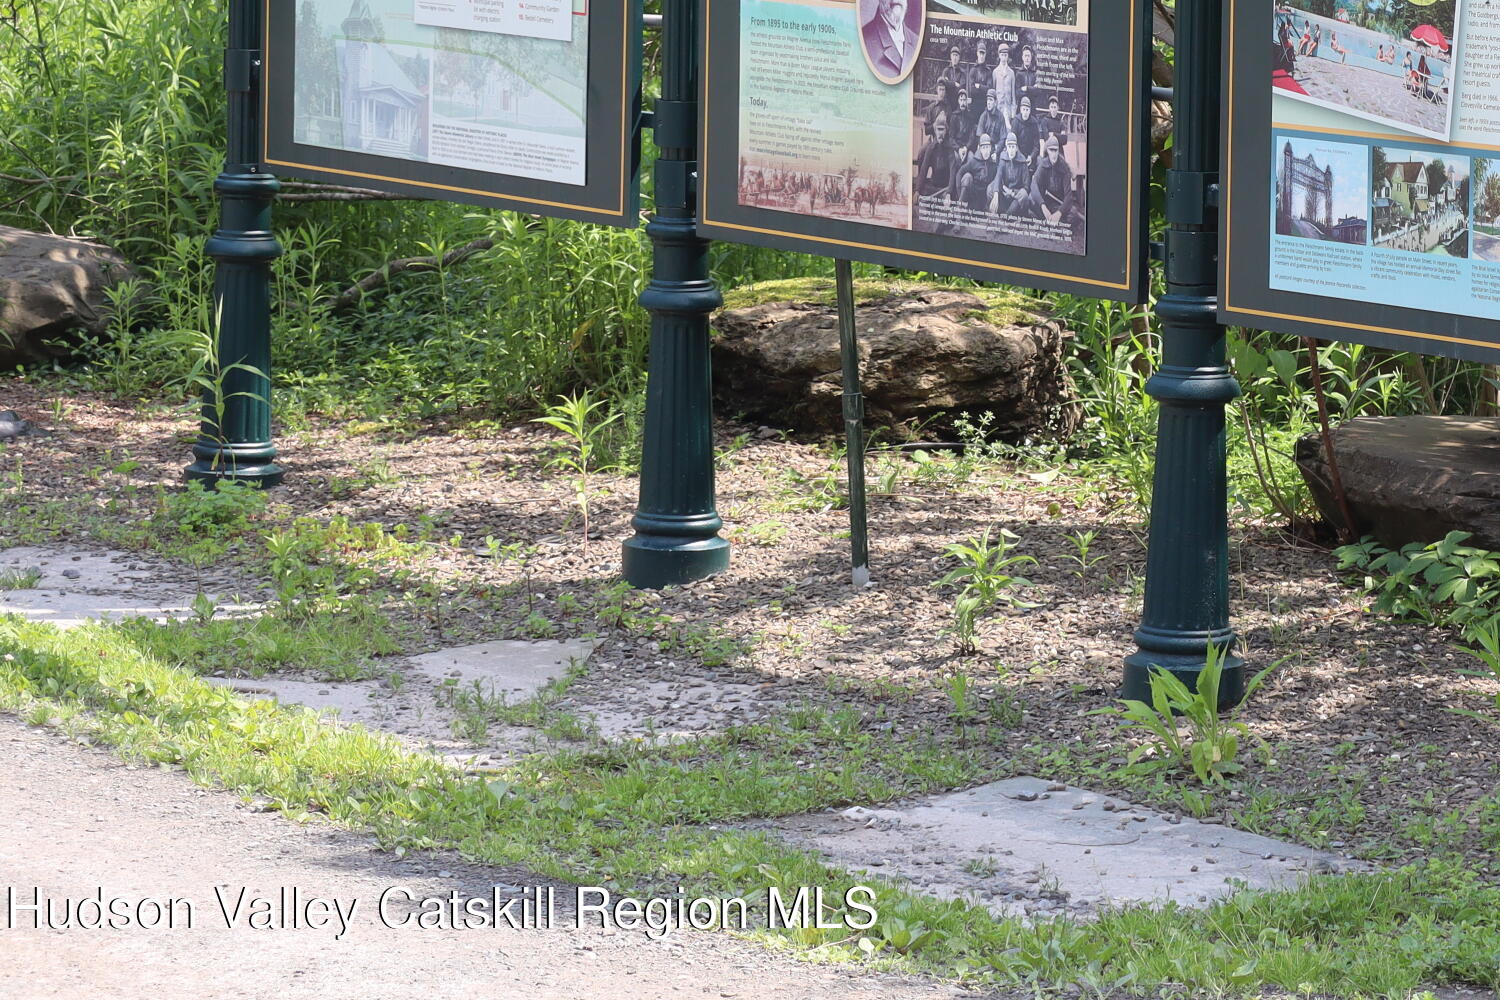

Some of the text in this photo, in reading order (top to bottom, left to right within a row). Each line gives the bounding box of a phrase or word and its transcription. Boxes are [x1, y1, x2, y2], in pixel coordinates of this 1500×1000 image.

[751, 17, 766, 26] From
[768, 19, 781, 28] 1895
[782, 21, 788, 29] to
[789, 21, 799, 30] the
[800, 23, 817, 34] early
[930, 24, 1018, 42] The Mountain Athletic Club
